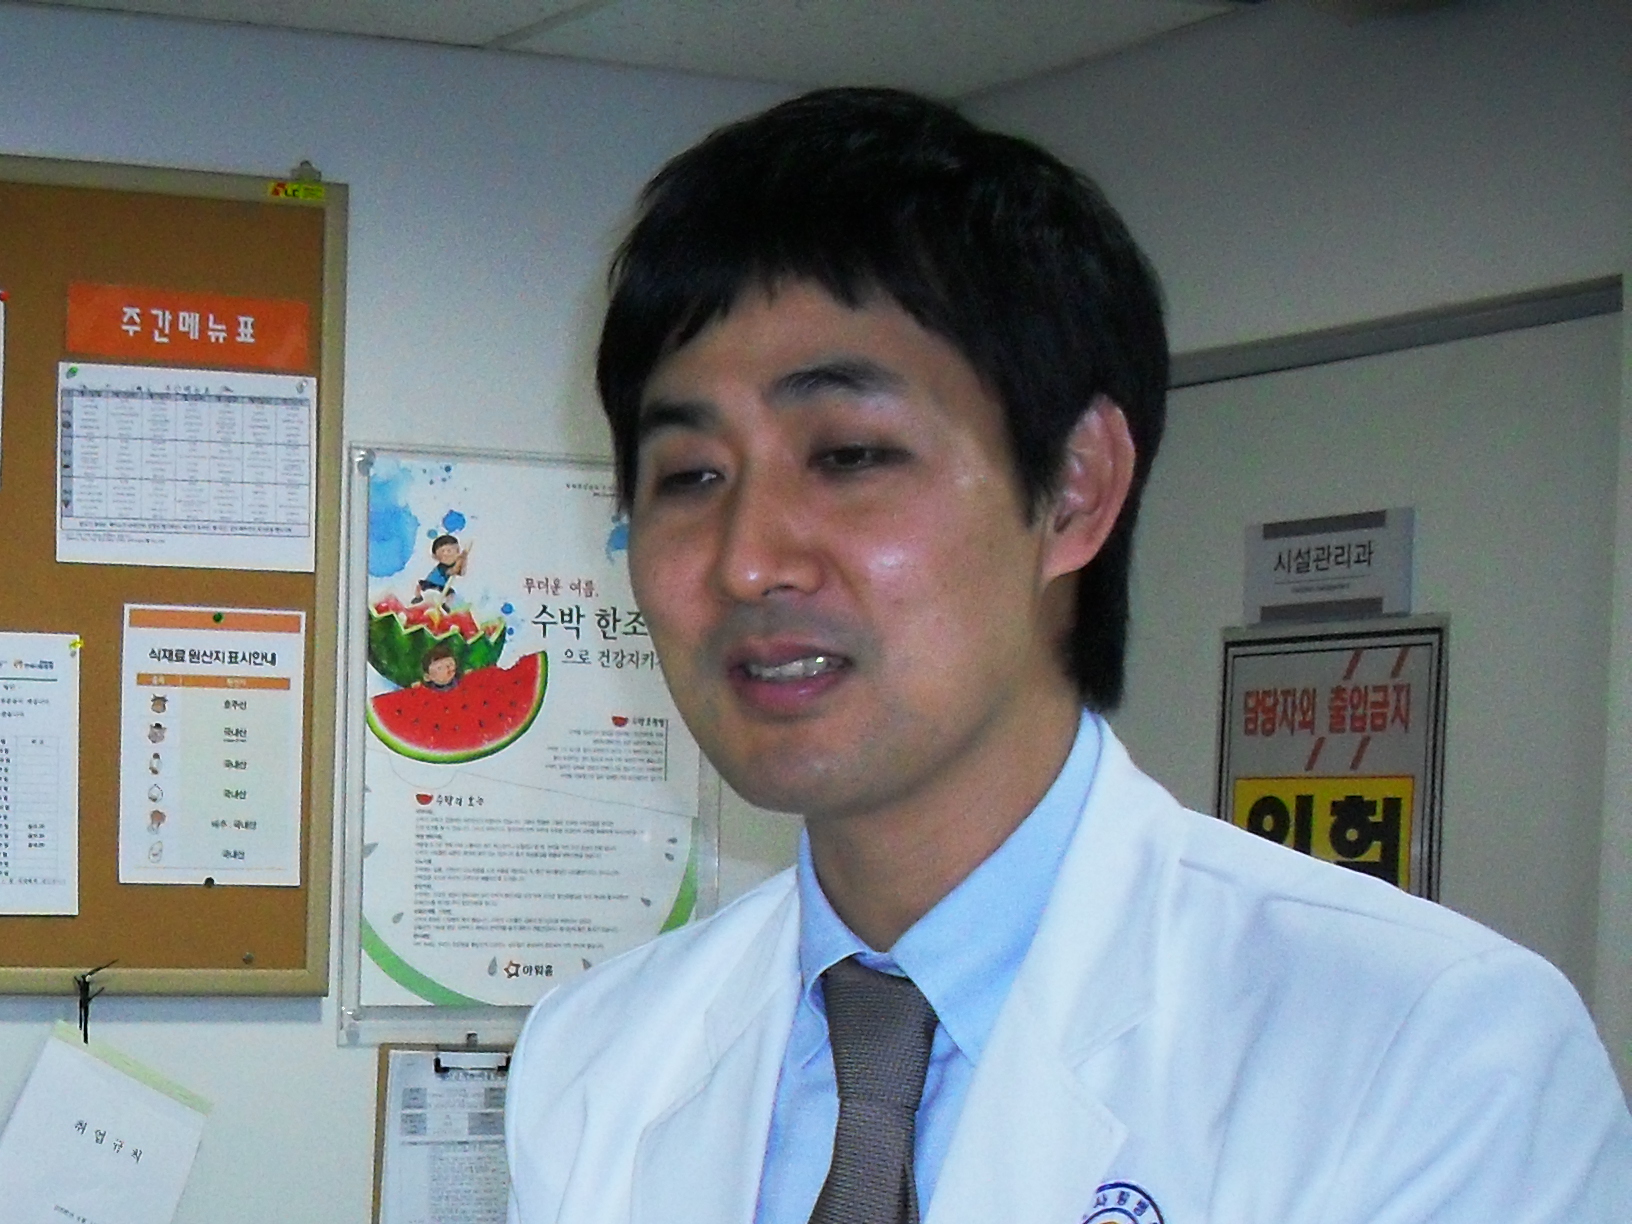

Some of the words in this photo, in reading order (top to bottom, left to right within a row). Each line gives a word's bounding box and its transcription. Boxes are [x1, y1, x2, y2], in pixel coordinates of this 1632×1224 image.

[121, 307, 256, 343] 주간메뉴표
[1274, 540, 1374, 574] 시설관리과
[523, 577, 563, 596] 무더운
[531, 604, 586, 640] 수박
[149, 648, 186, 663] 식재료
[188, 649, 226, 665] 원산지
[228, 650, 277, 667] 표시안내
[561, 649, 593, 665] 으로
[598, 649, 660, 670] 건강지키
[1243, 687, 1317, 736] 담당자외
[1329, 683, 1410, 734] 출입금지
[223, 727, 247, 738] 국내산
[223, 759, 247, 770] 국내산
[223, 789, 247, 800] 국내산
[222, 849, 245, 860] 국내산
